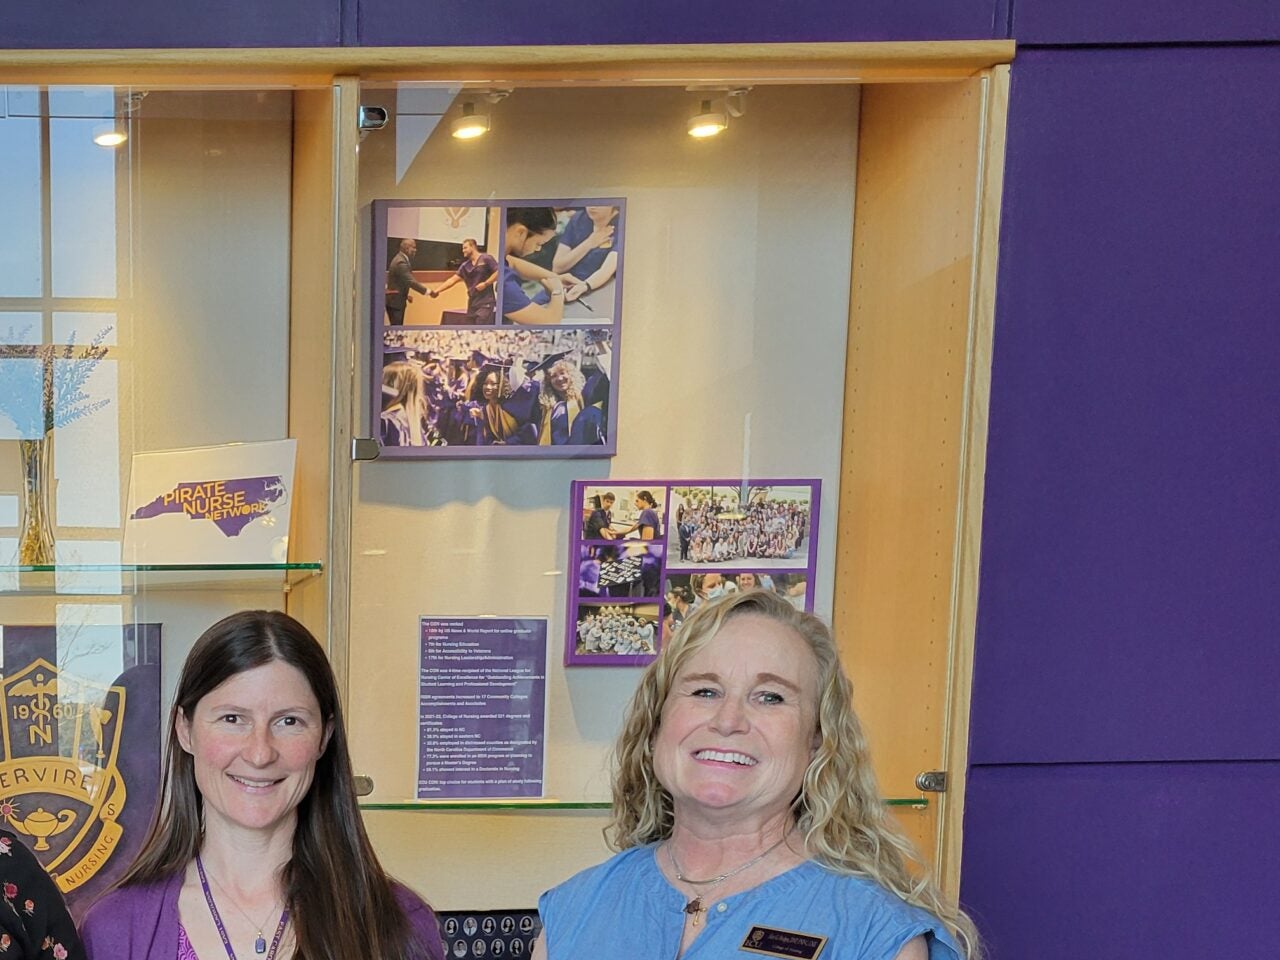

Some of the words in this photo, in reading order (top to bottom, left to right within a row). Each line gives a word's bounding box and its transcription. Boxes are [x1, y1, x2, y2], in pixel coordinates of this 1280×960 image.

[163, 481, 226, 506] PIRATE
[183, 491, 246, 515] NURSE
[205, 501, 268, 521] NETWORK
[12, 705, 29, 719] 19
[52, 704, 74, 720] 60
[29, 724, 52, 744] N
[107, 803, 116, 816] S
[65, 834, 114, 886] NURSING
